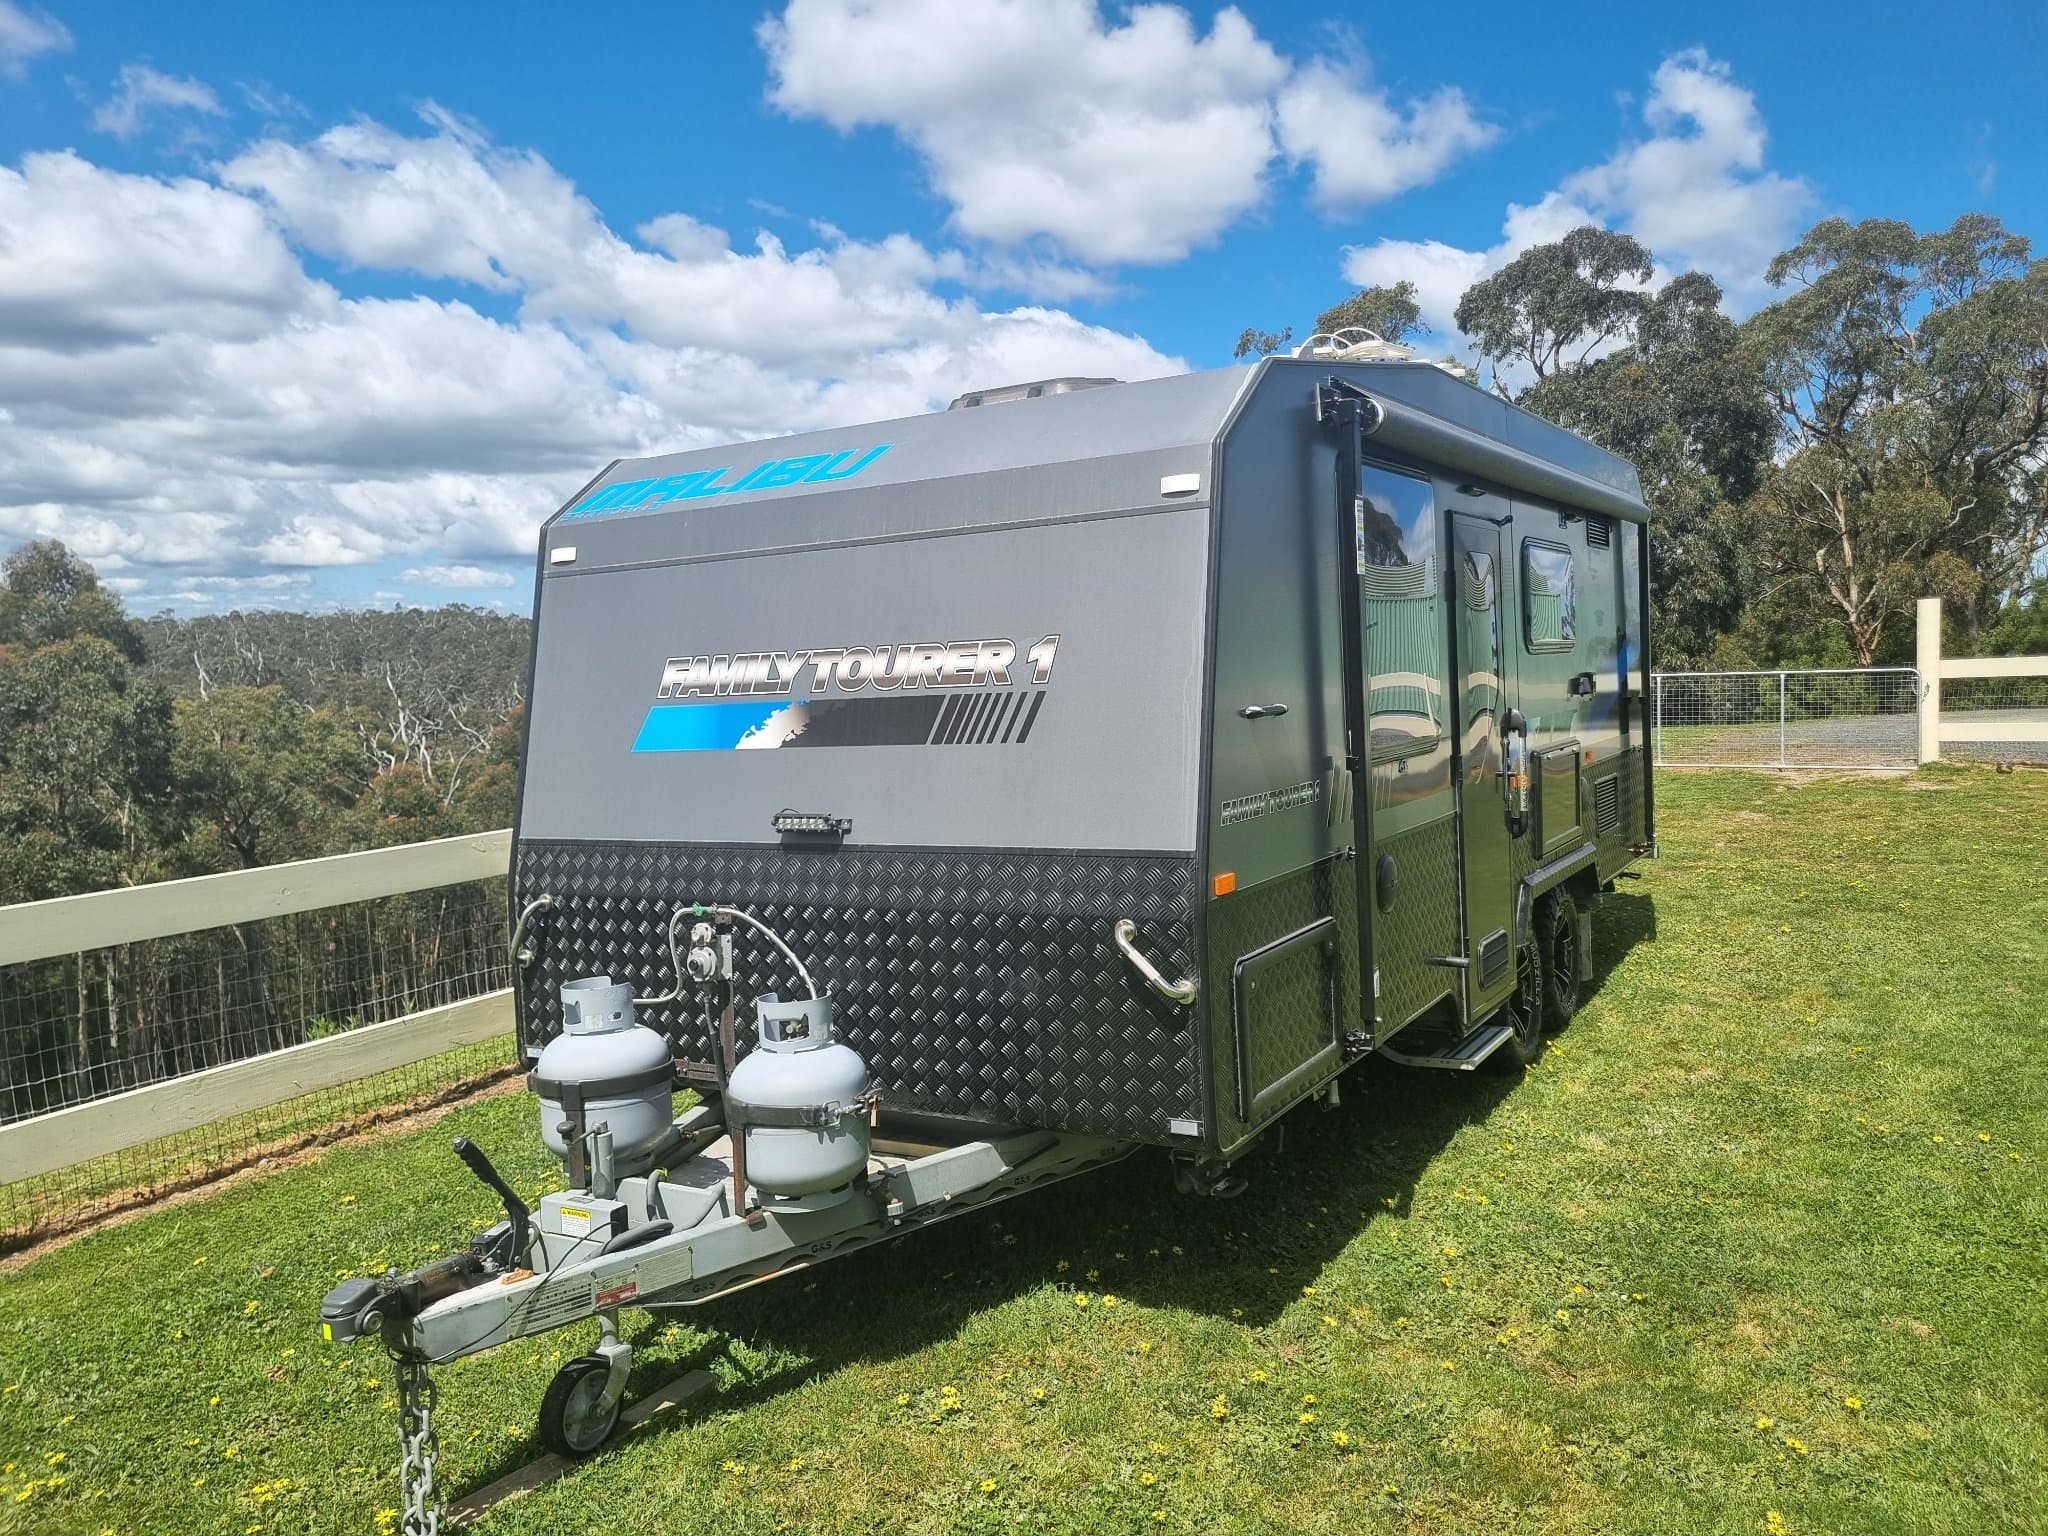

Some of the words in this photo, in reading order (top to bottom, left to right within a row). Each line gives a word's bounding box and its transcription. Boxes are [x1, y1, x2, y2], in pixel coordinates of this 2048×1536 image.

[567, 443, 896, 515] MALIBU
[656, 650, 811, 699] FAMILY
[807, 639, 1016, 694] TOURER
[1026, 634, 1061, 685] 1
[1220, 792, 1269, 827] FAMILY
[1267, 781, 1314, 814] TOURER
